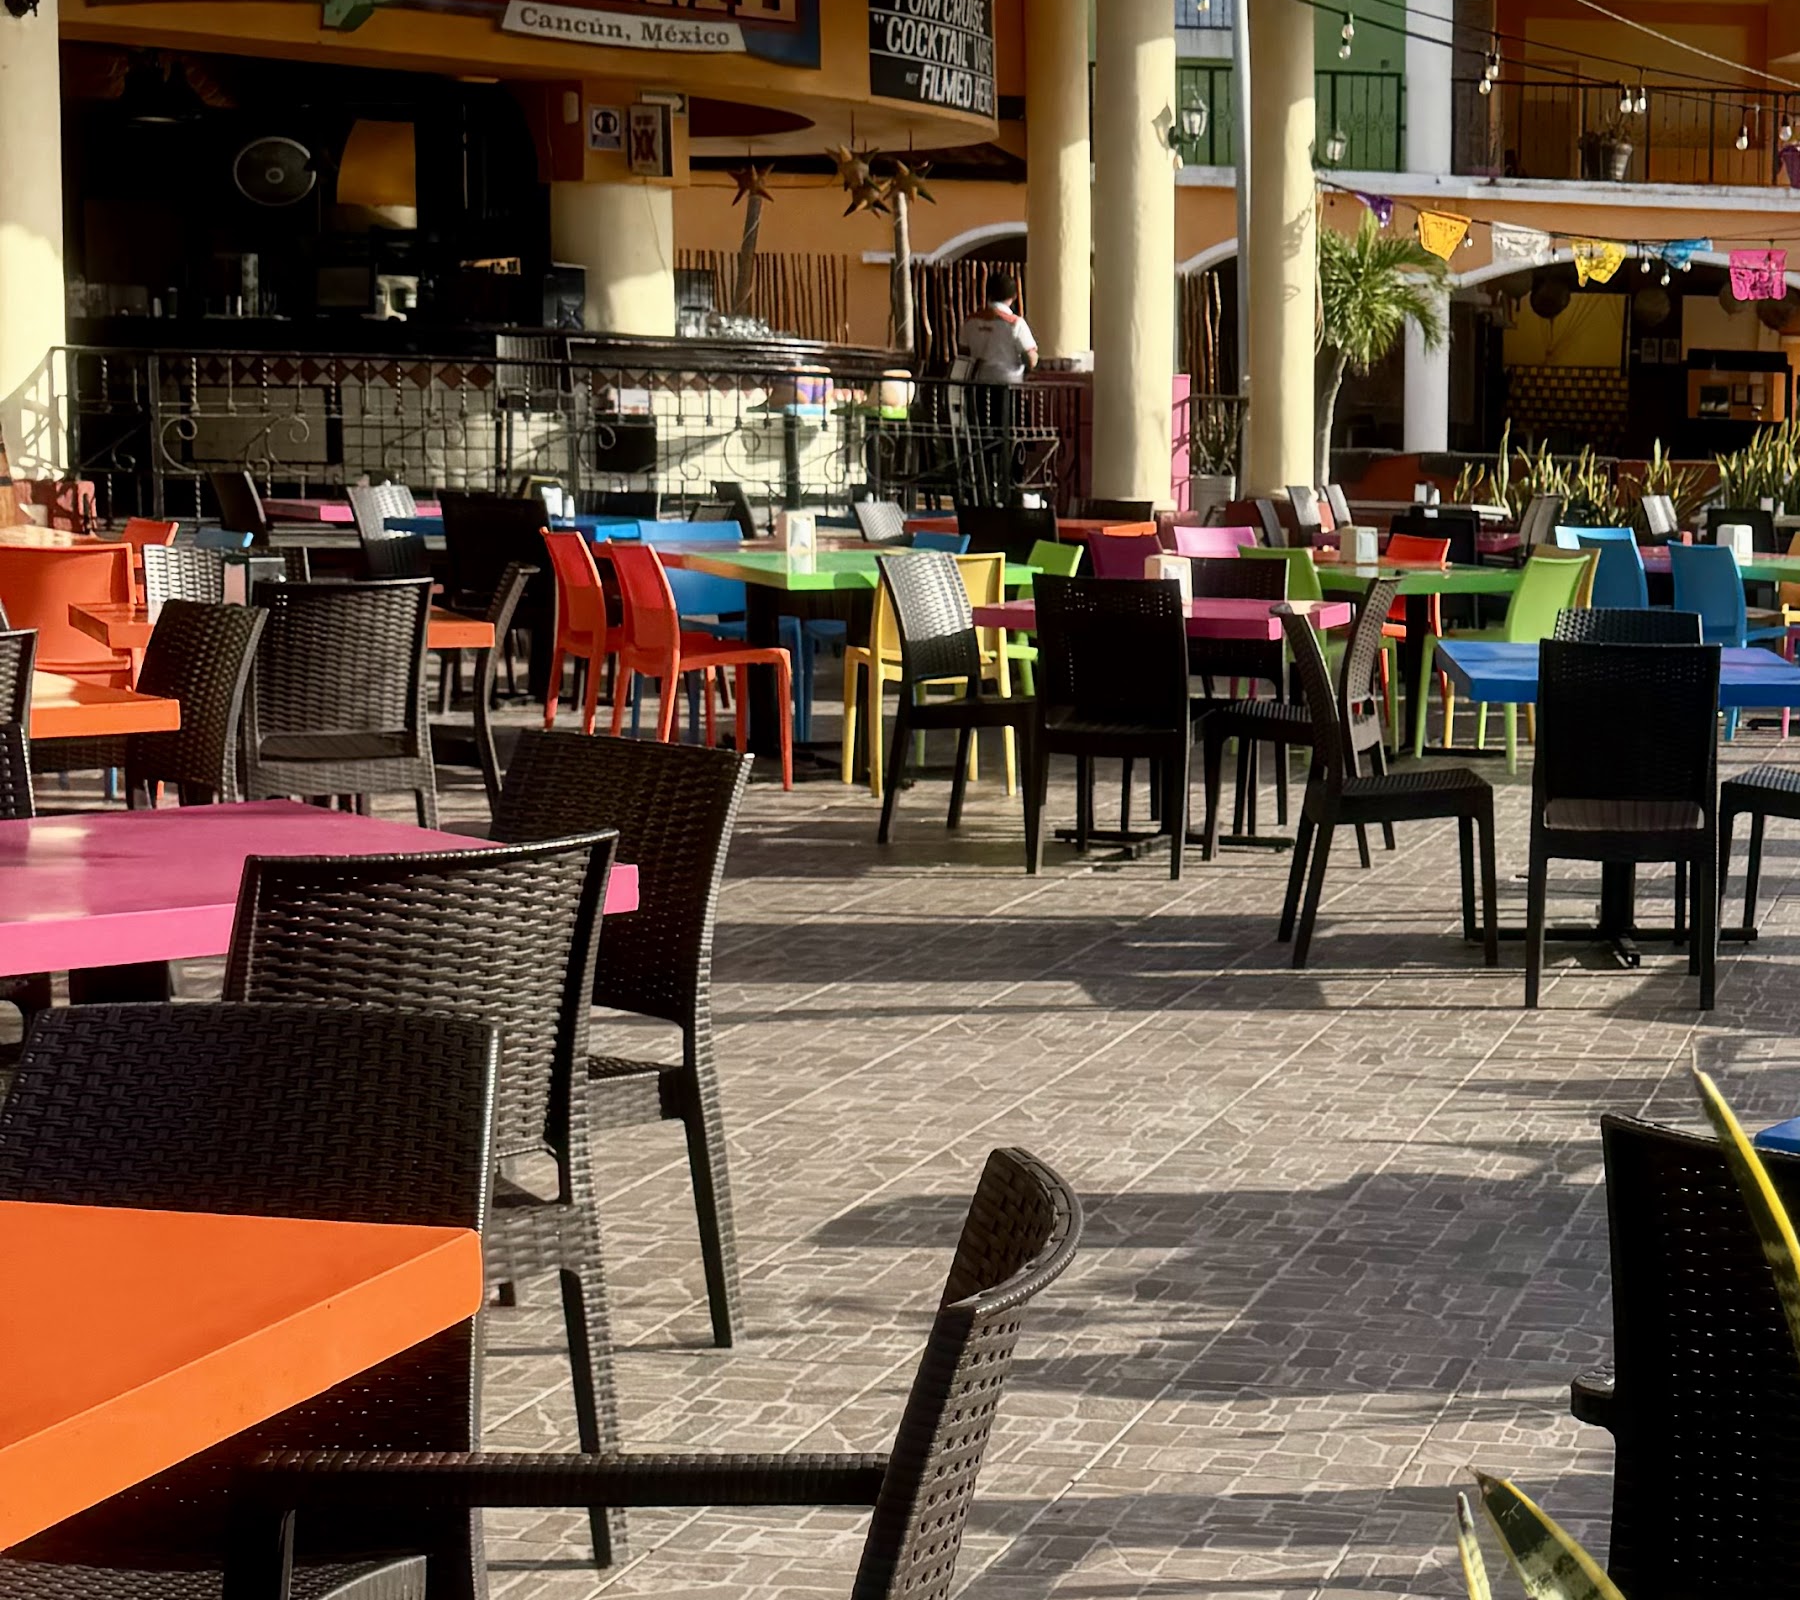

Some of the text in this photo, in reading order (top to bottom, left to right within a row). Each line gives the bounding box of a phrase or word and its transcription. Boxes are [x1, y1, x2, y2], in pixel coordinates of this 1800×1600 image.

[519, 6, 730, 46] Cancún, México
[920, 64, 973, 109] FILMED
